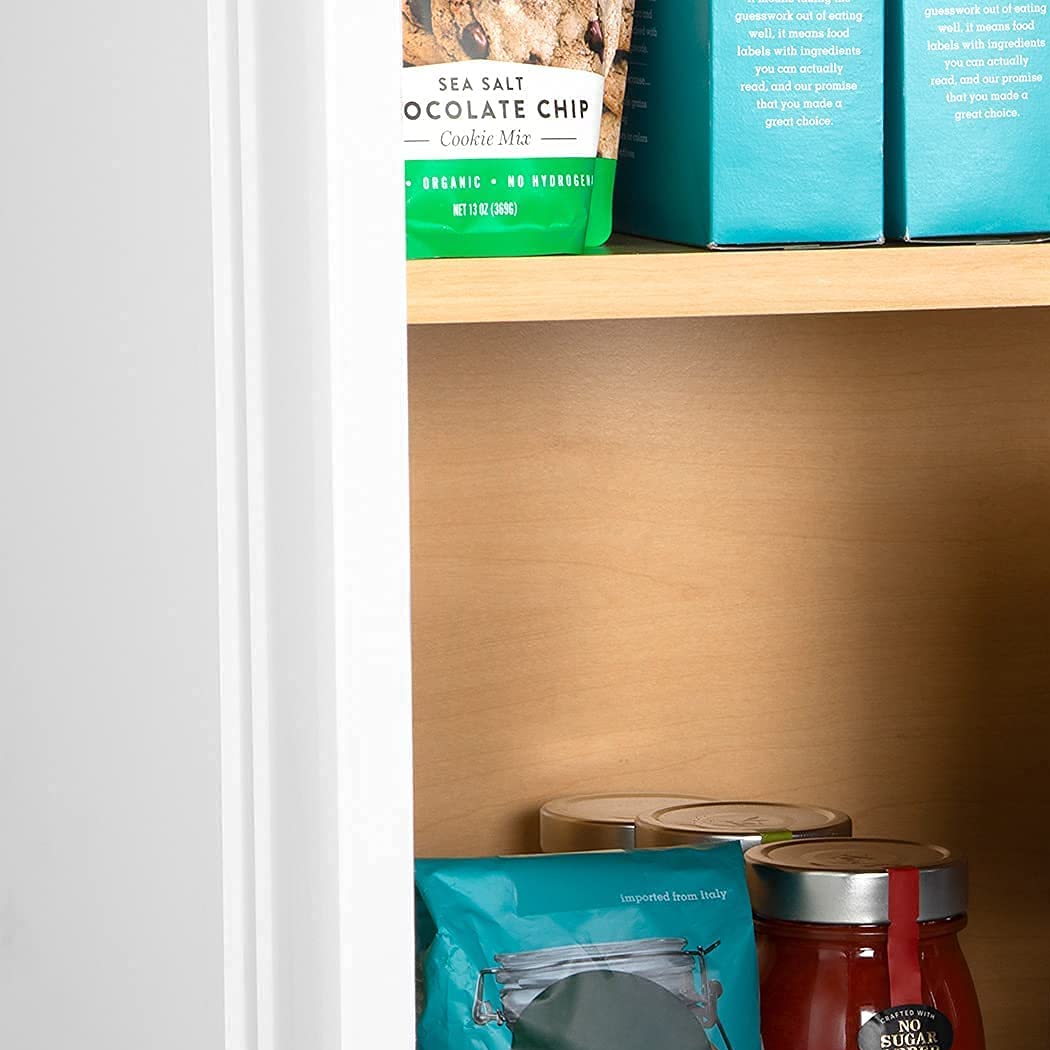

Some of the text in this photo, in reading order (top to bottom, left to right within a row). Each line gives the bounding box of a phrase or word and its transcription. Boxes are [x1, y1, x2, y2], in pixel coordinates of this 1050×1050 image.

[735, 10, 863, 23] guesswork out of eating
[924, 4, 1047, 18] guesswork out of eating
[749, 28, 850, 39] well, it means food
[938, 20, 1035, 33] well, it means food
[737, 45, 861, 57] labels with ingredients
[927, 37, 1046, 51] labels with ingredients
[755, 63, 843, 76] you can actually
[944, 55, 1029, 70] you can actually
[438, 76, 524, 91] SEA SALT
[740, 80, 857, 93] read, and our promise
[930, 72, 1042, 87] read, and our promise
[756, 98, 843, 111] that you made a
[946, 91, 1029, 104] that you made a
[403, 99, 589, 121] OCOLATE CHIP
[955, 107, 1020, 122] great choice.
[765, 115, 833, 129] great choice.
[440, 130, 531, 146] Cookie Mix
[422, 176, 481, 190] ORGANIC
[507, 175, 524, 188] NO
[453, 202, 518, 217] NET 13 OZ (369G)
[620, 889, 727, 904] imported from Italy
[880, 1009, 935, 1024] CRAFTED WITH
[898, 1019, 921, 1033] NO
[881, 1031, 938, 1049] SUGAR
